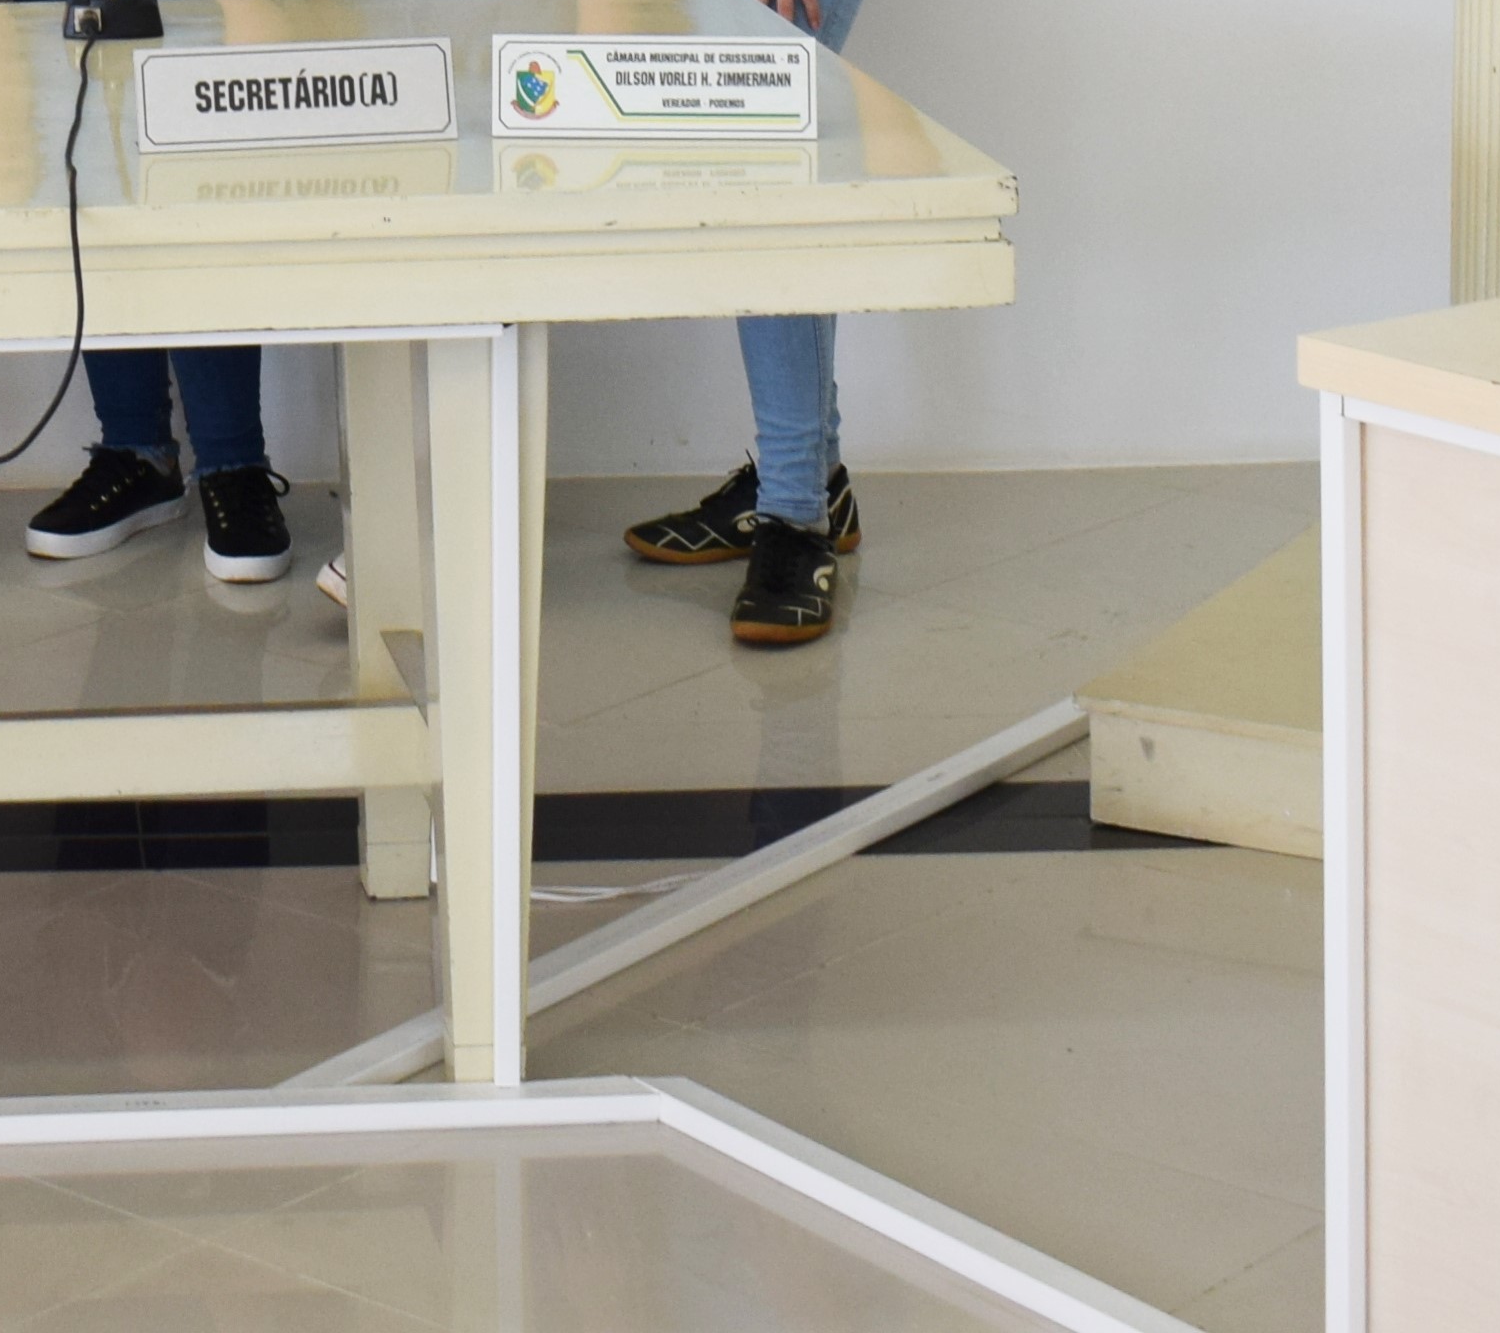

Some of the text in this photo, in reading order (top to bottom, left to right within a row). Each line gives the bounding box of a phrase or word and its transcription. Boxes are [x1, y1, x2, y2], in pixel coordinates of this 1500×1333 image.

[606, 50, 647, 63] CÂMARA
[649, 52, 700, 64] MUNICIPAL
[704, 52, 715, 64] DE
[719, 52, 777, 64] CRISSIUMAL
[787, 53, 800, 64] RS
[615, 71, 792, 87] DILSON VORLEI H. ZIMMERMANN
[195, 68, 398, 113] SECRETÁRIO(A)
[662, 98, 701, 109] VEREADOR
[709, 98, 746, 109] PODEMOS
